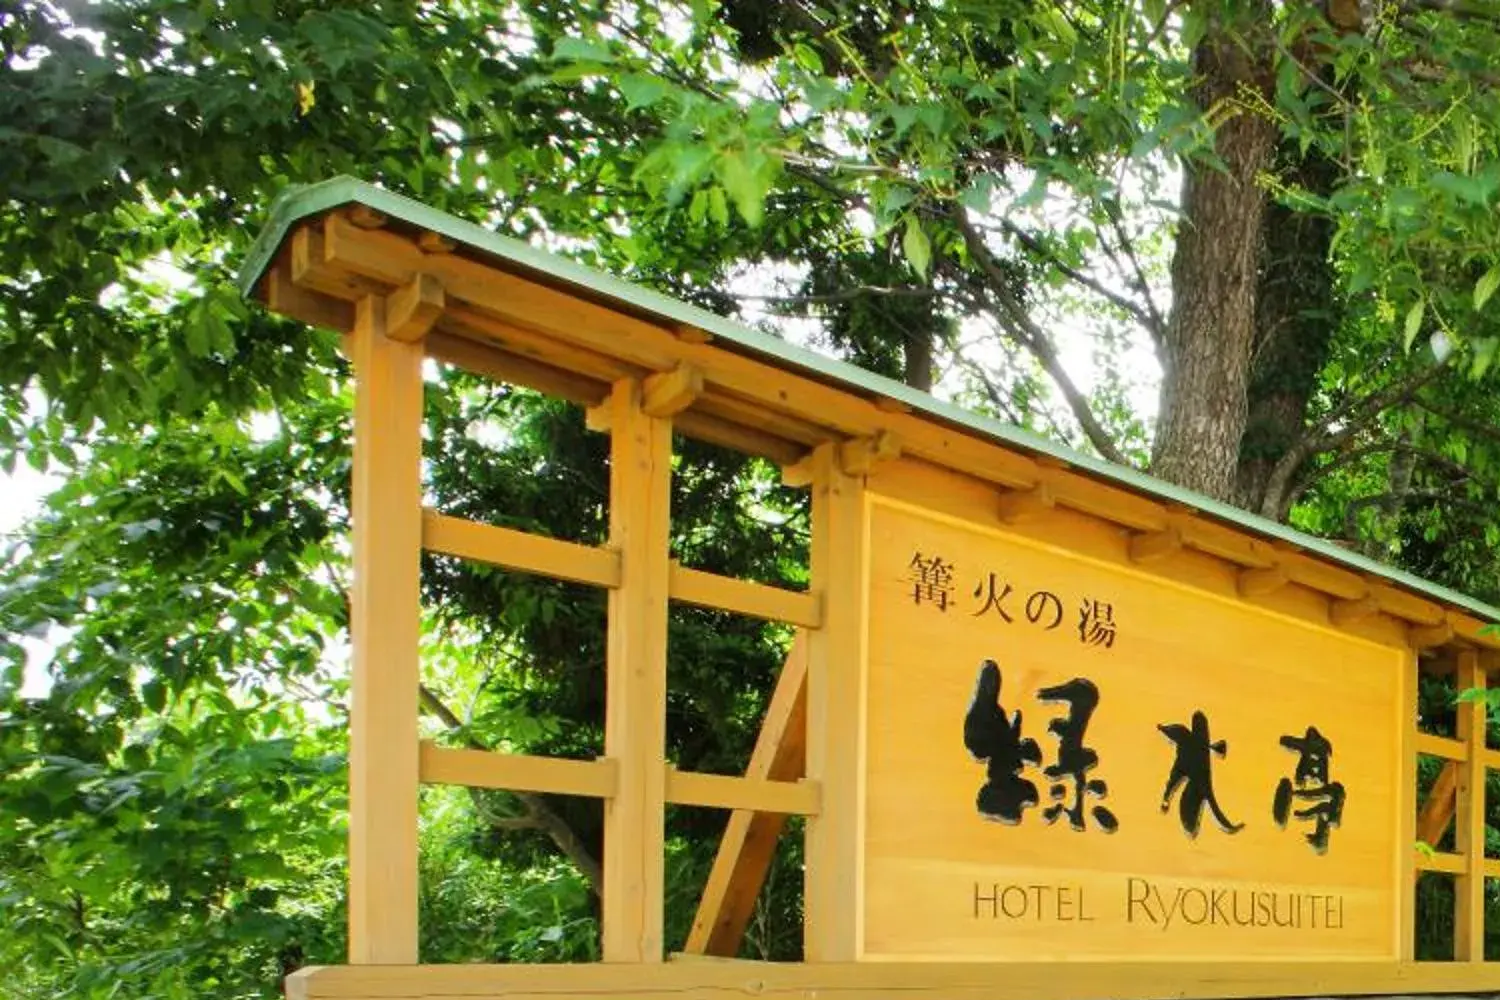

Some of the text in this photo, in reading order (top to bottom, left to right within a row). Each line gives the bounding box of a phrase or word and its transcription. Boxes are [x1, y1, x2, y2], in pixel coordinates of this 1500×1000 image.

[908, 552, 1117, 649] 篝火の湯
[963, 659, 1346, 855] 緑水亭
[974, 881, 1094, 922] HOTEL
